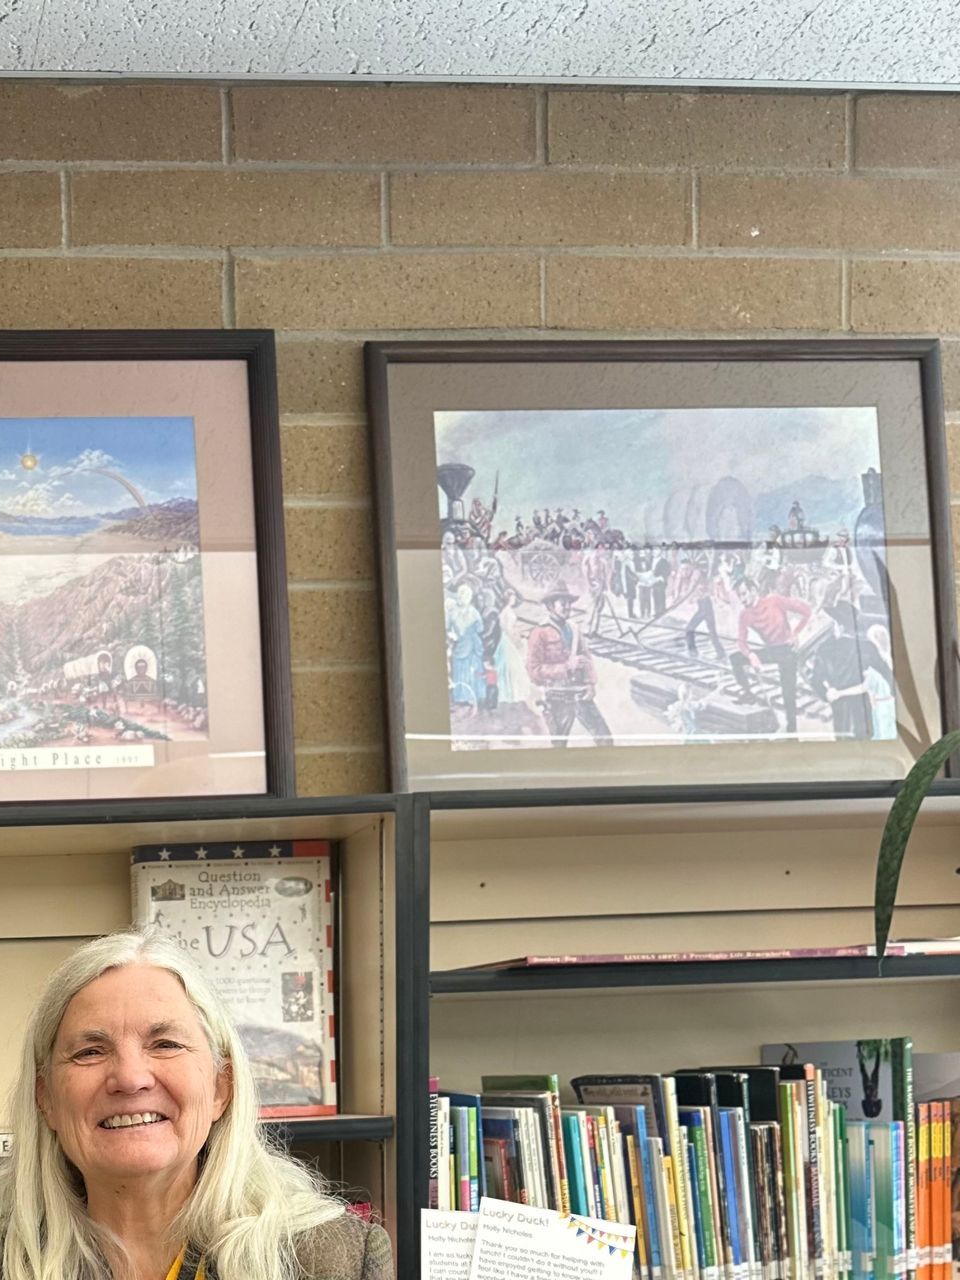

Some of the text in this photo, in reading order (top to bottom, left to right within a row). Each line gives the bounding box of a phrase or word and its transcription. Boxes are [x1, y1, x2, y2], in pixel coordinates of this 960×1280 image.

[52, 754, 102, 766] Place
[198, 871, 261, 883] Question
[189, 884, 271, 896] and Answer
[190, 898, 271, 912] Encyclopedia
[202, 922, 295, 958] USA
[806, 1079, 816, 1132] EYEWITNESS
[429, 1093, 439, 1147] EYEWITNESS
[808, 1133, 818, 1163] BOOKS
[429, 1152, 439, 1180] BOOKS
[483, 1208, 549, 1226] Lucky Duck!
[426, 1220, 457, 1231] Lucky
[483, 1224, 500, 1233] Holly
[482, 1240, 502, 1249] Thank
[505, 1244, 518, 1252] you
